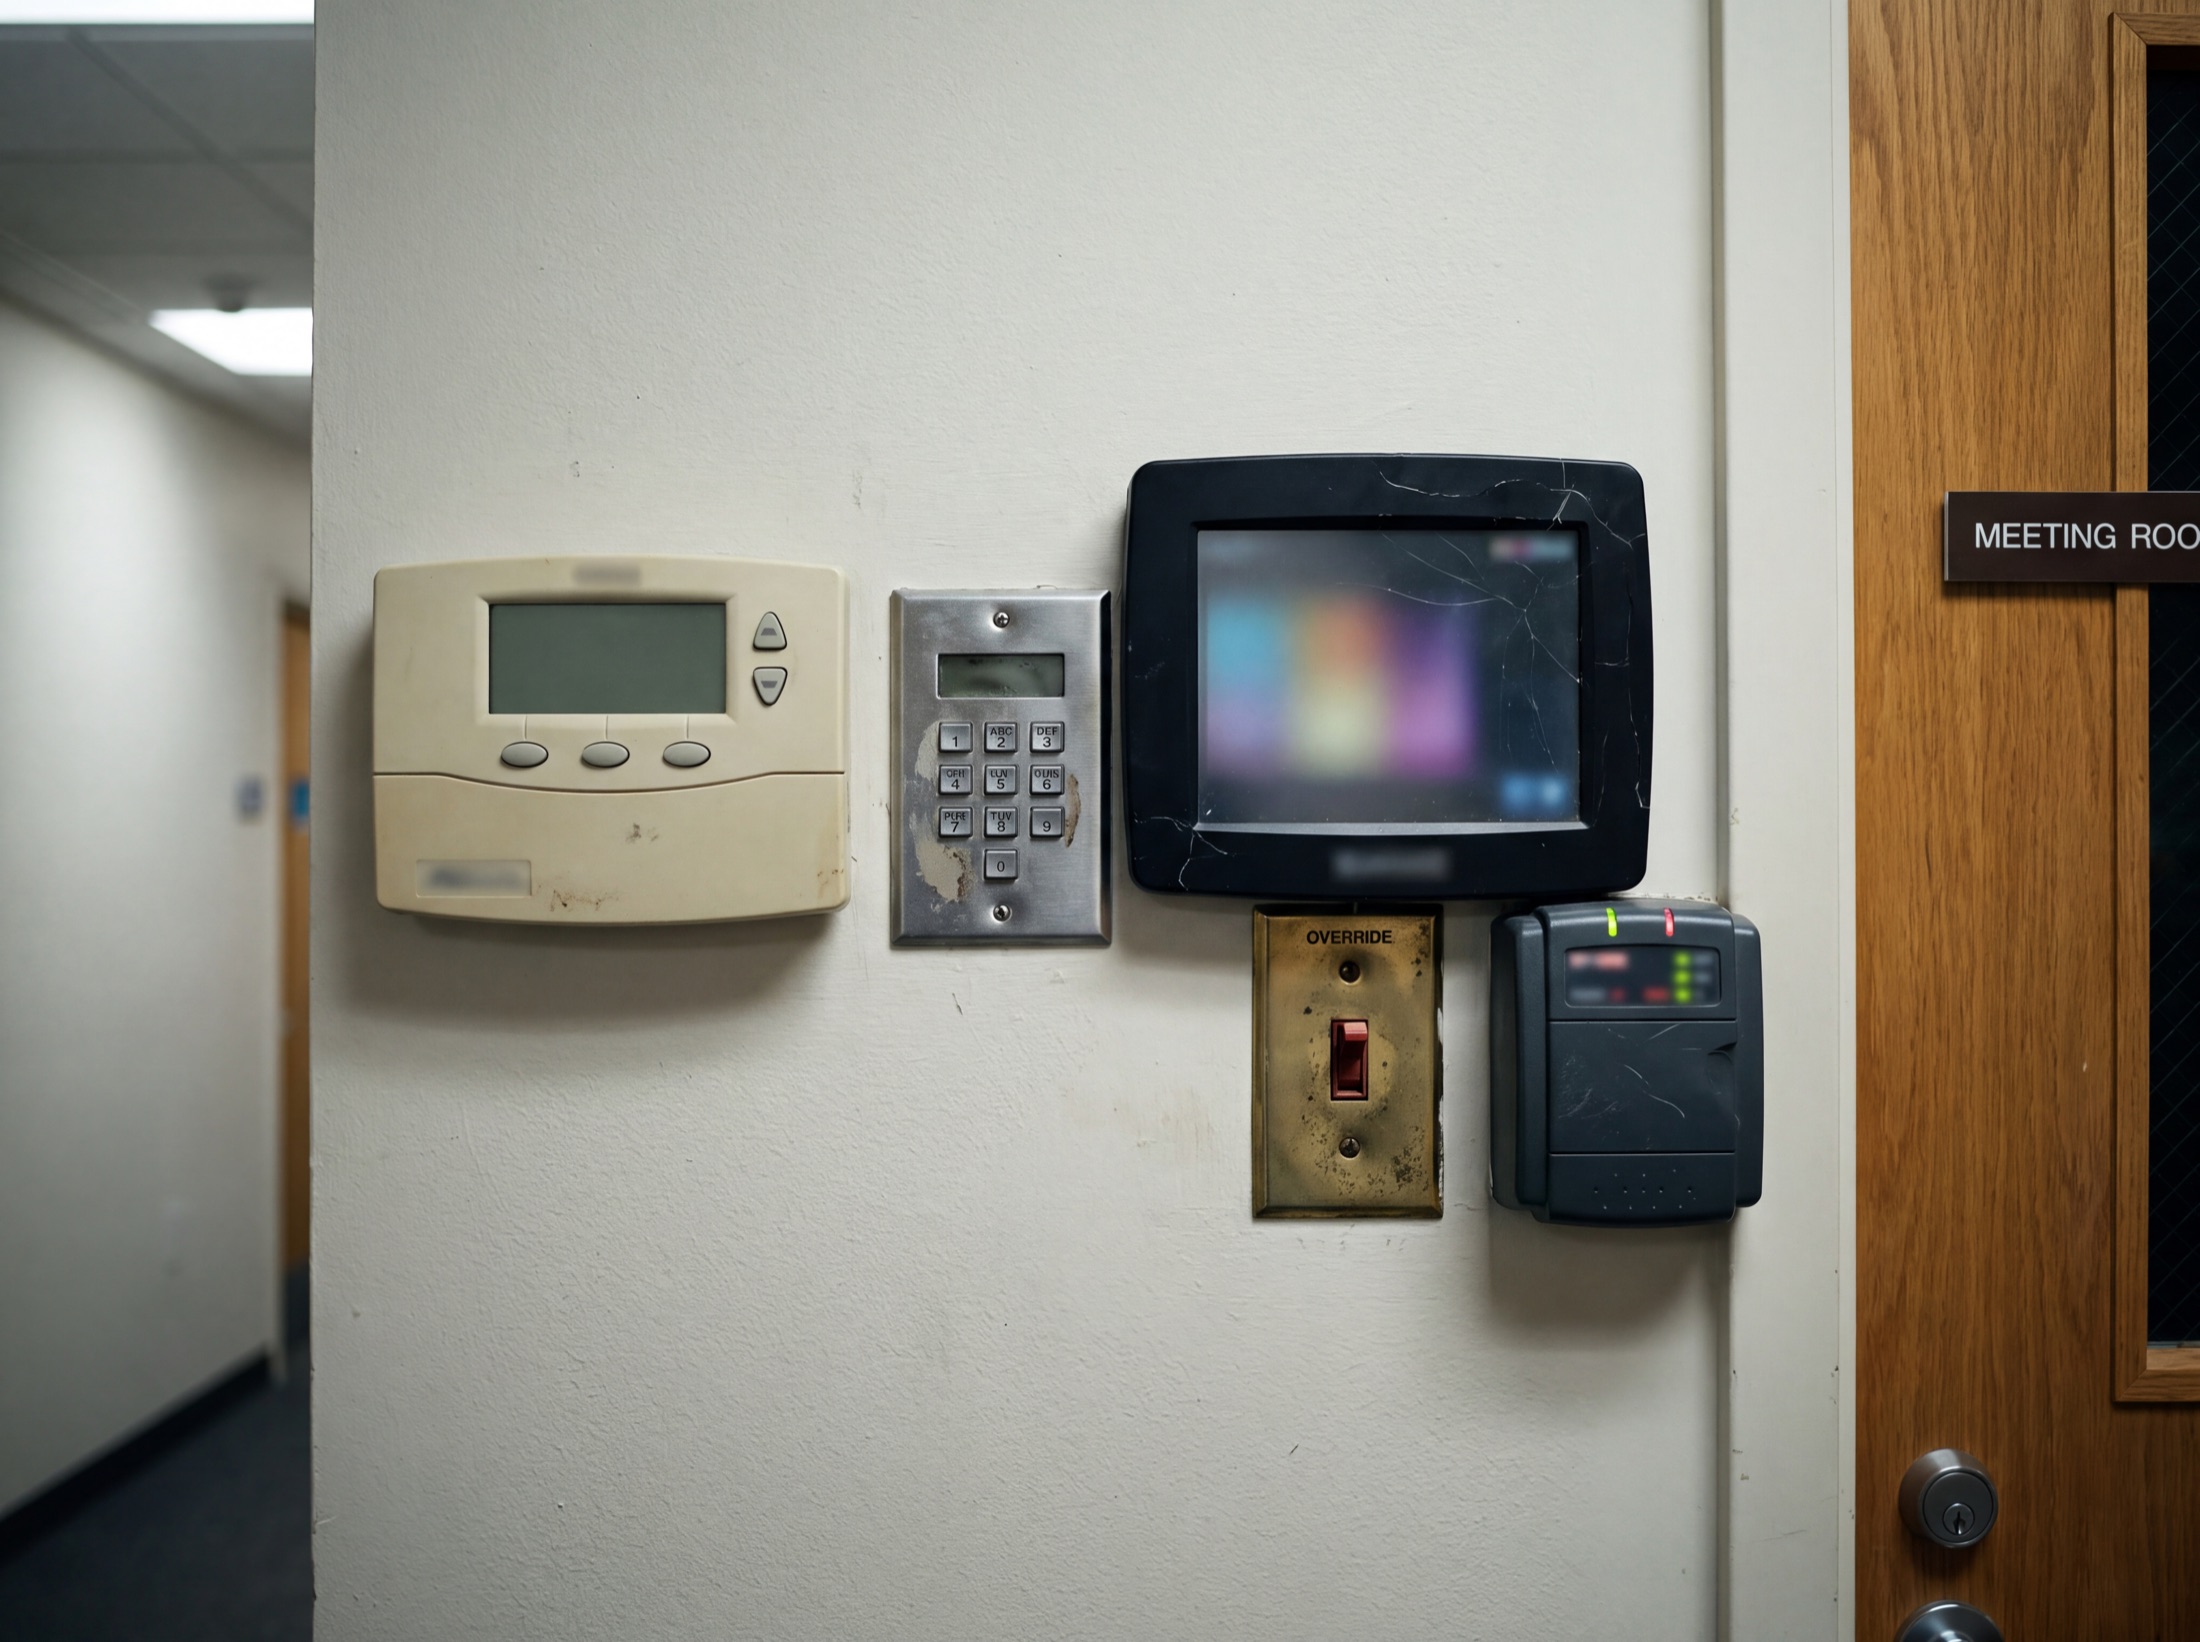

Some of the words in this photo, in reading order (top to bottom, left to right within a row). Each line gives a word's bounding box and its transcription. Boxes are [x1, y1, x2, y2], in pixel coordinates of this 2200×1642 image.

[1975, 522, 2117, 549] MEETING
[2131, 523, 2200, 550] ROO
[990, 727, 1013, 736] ABC
[1036, 727, 1058, 736] DEF
[952, 736, 958, 748] 1
[997, 737, 1006, 748] 2
[1042, 737, 1051, 748] 3
[951, 779, 960, 790] 4
[996, 778, 1005, 790] 5
[1042, 778, 1051, 790] 6
[990, 811, 1012, 821] TUV
[950, 821, 960, 833] 7
[997, 821, 1006, 833] 8
[1042, 820, 1051, 833] 9
[996, 860, 1005, 873] 0
[1306, 930, 1393, 945] OVERRIDE
